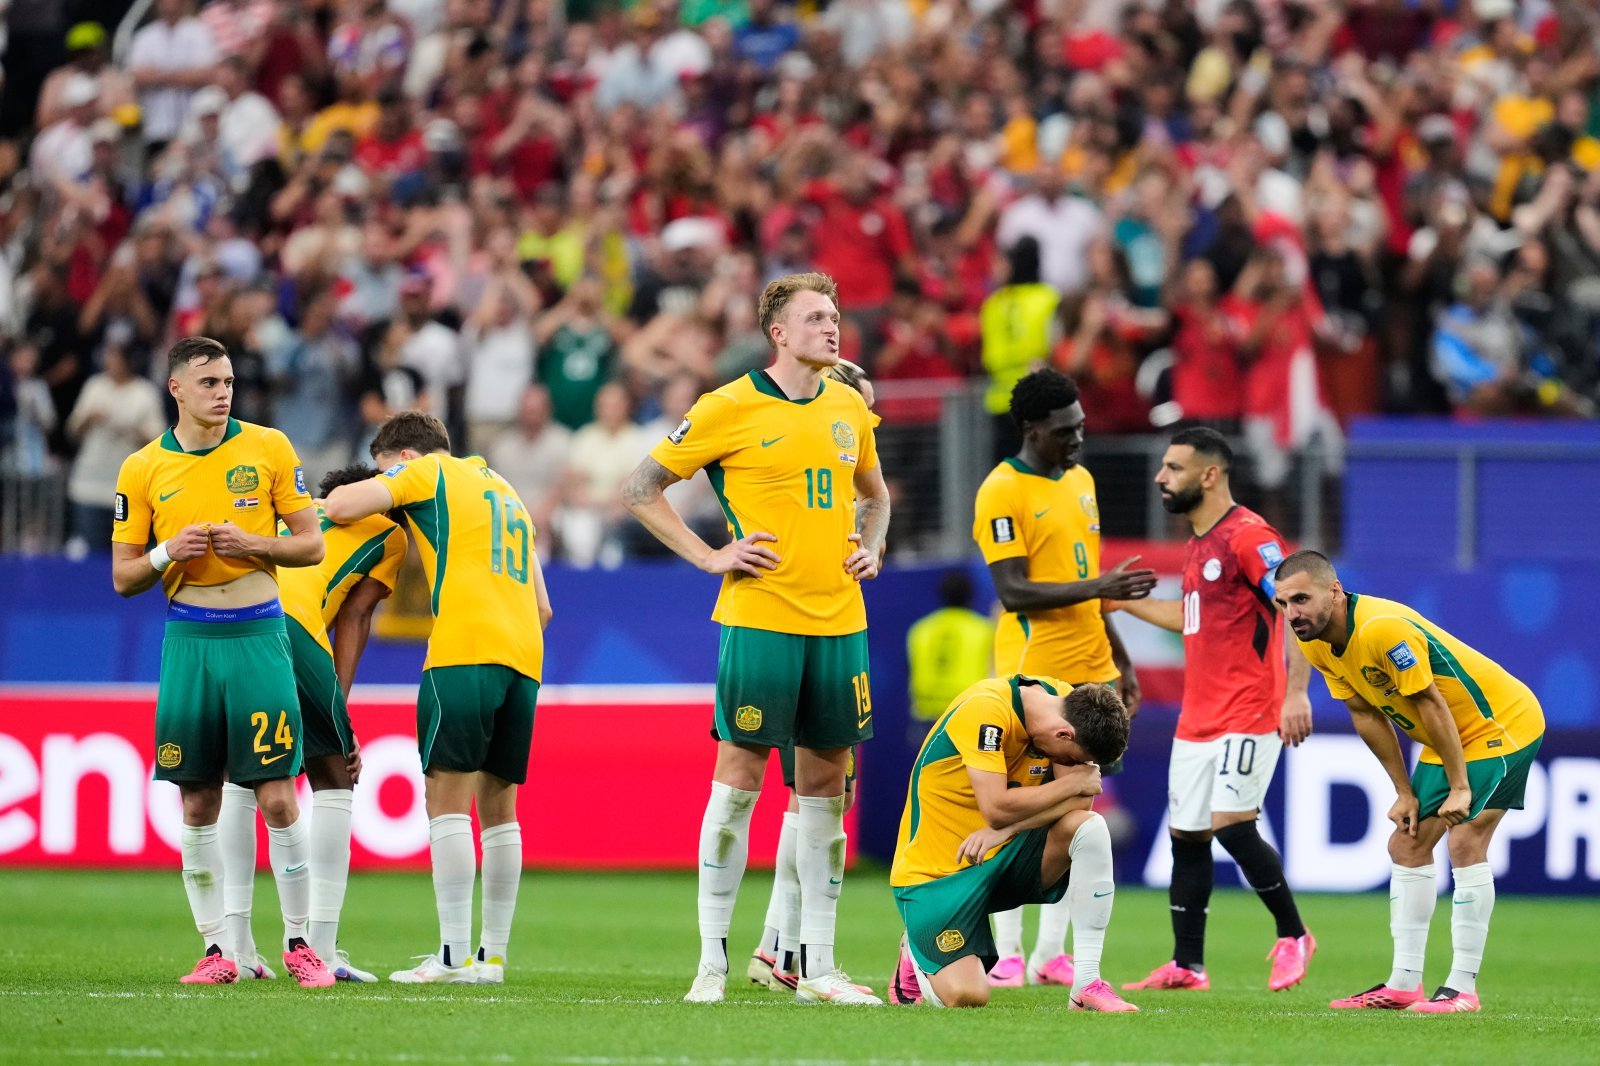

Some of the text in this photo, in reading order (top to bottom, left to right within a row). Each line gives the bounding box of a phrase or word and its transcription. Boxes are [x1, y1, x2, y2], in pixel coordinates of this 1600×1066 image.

[805, 468, 832, 509] 19
[484, 490, 529, 584] 15
[1074, 542, 1088, 579] 9
[1184, 591, 1201, 636] 10
[852, 672, 872, 717] 19
[251, 710, 294, 753] 24
[1219, 738, 1257, 776] 10
